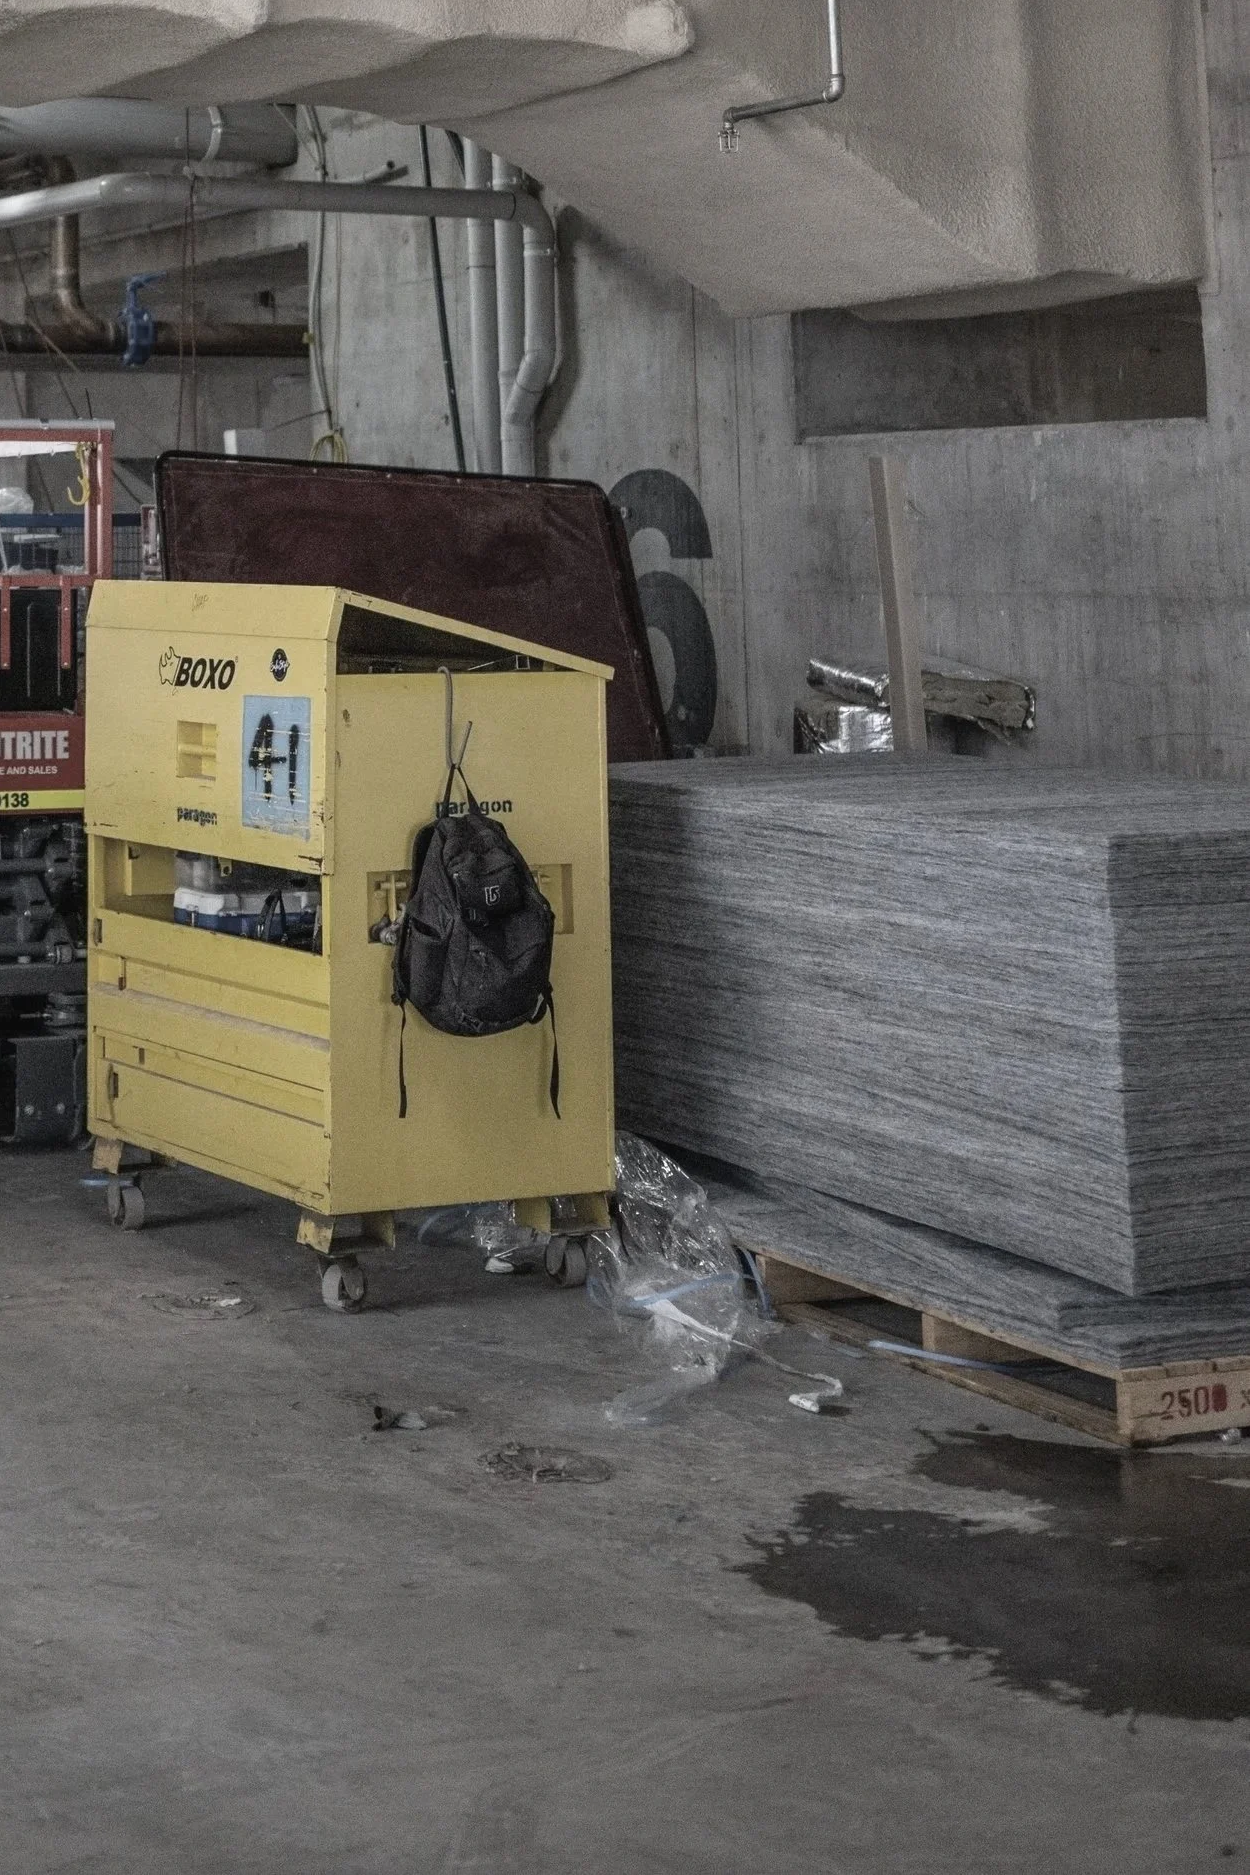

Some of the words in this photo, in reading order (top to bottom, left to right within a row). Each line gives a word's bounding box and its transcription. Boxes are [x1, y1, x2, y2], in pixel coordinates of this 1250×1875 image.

[175, 657, 236, 690] BOXO
[249, 713, 300, 806] 41
[6, 766, 26, 775] AND
[28, 765, 58, 775] SALES
[177, 807, 217, 827] paragon
[435, 799, 513, 818] pargon
